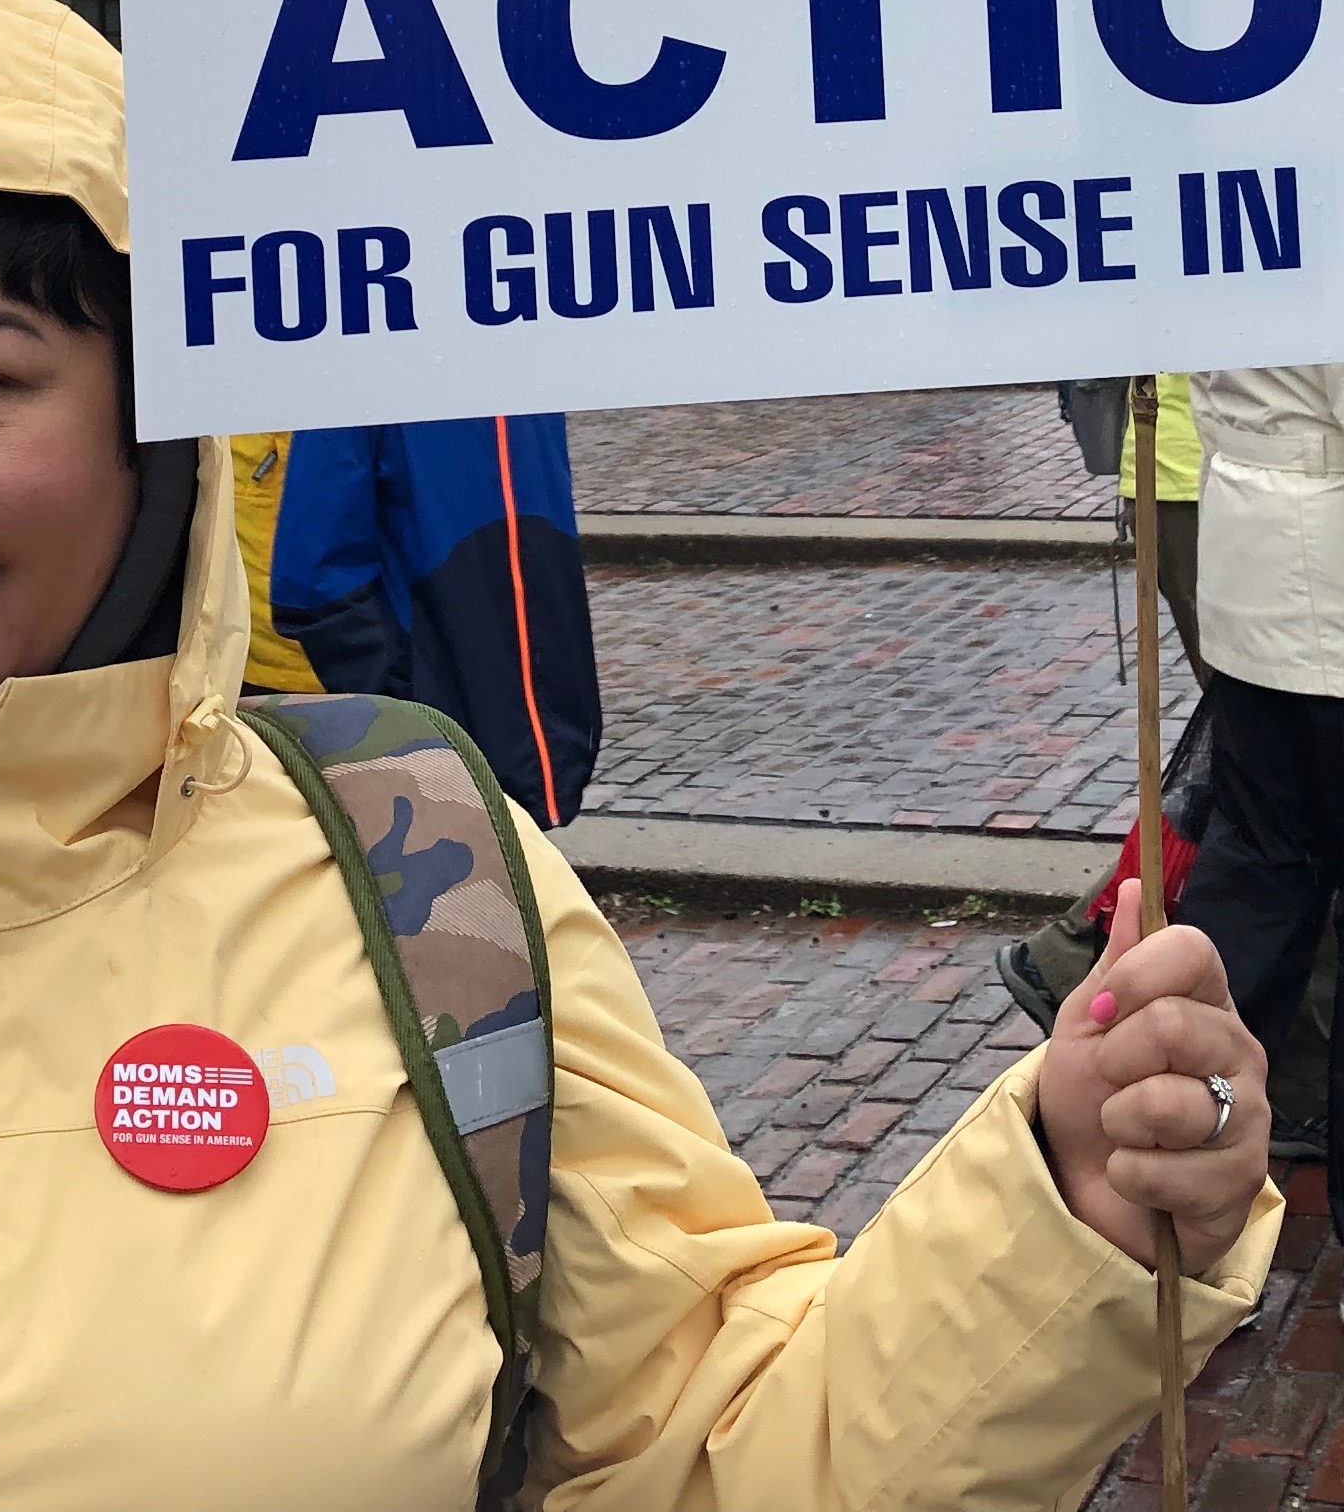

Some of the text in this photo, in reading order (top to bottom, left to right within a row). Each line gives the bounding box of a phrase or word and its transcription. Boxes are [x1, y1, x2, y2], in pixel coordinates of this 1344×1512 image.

[182, 227, 418, 346] FOR
[463, 203, 714, 325] GUN
[762, 177, 1136, 303] SENSE
[1179, 167, 1301, 275] IN
[113, 1063, 202, 1084] MOMS
[113, 1086, 238, 1108] DEMAND
[112, 1109, 222, 1131] ACTION
[113, 1133, 253, 1147] FOR GUN SENSE IN AMERICA
